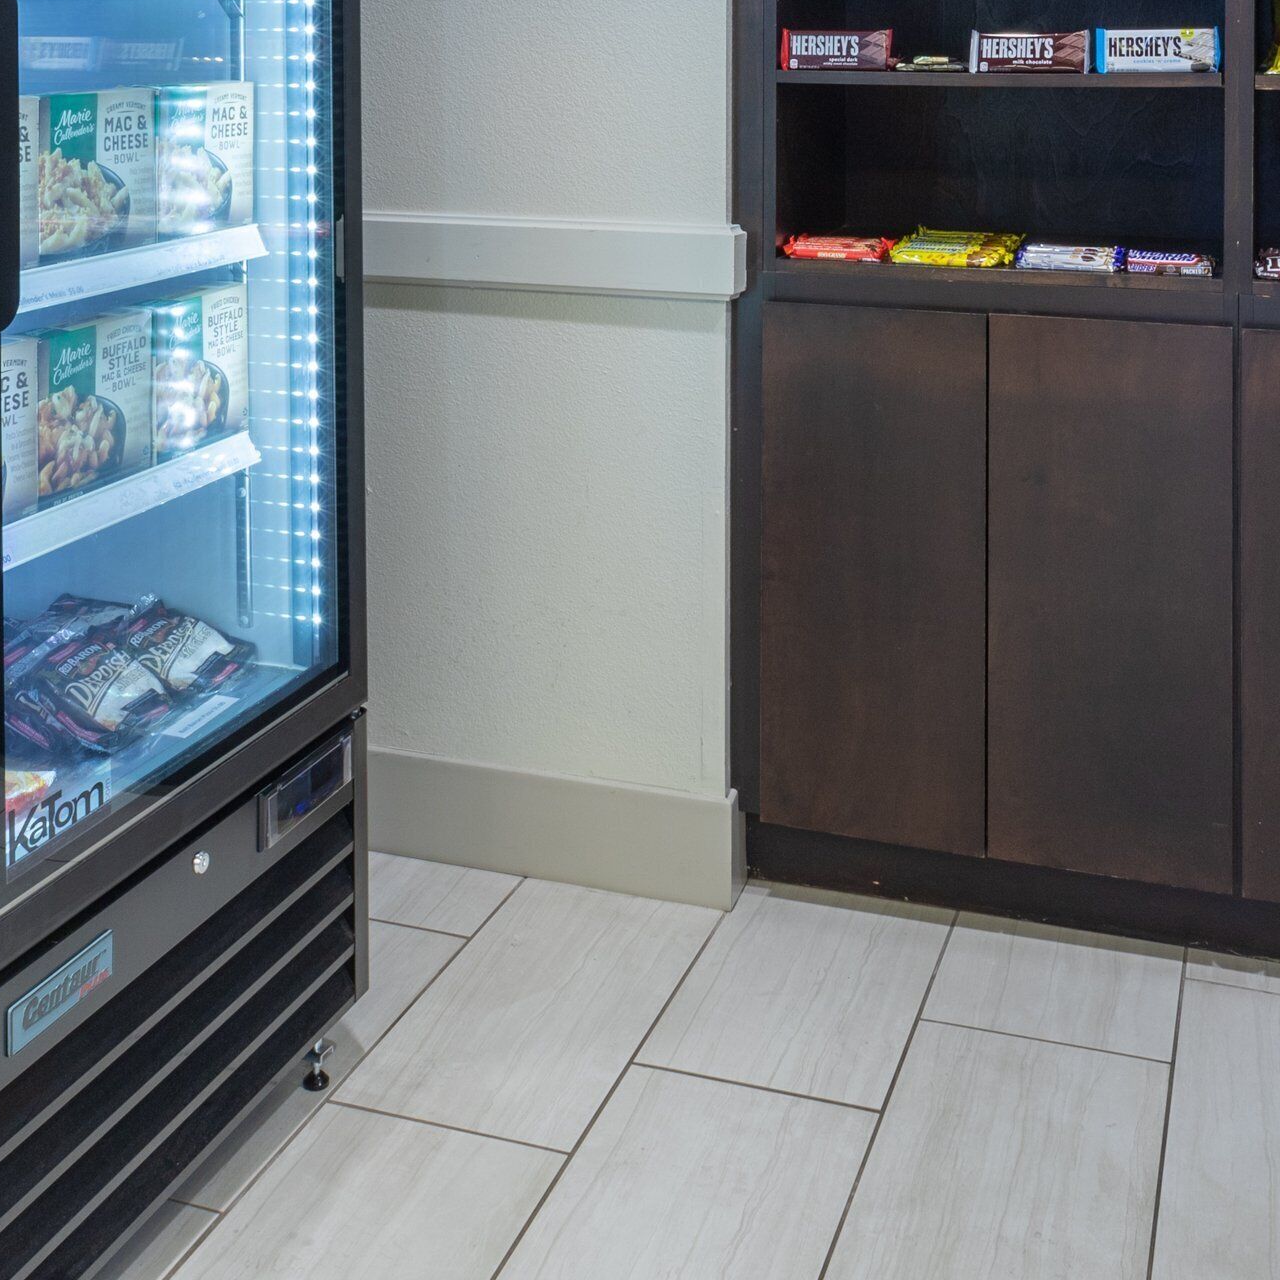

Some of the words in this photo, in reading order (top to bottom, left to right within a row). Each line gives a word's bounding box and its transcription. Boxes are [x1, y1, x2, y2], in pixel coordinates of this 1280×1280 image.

[792, 35, 860, 56] HERSHEY'S
[981, 37, 1054, 59] HERSHEY'S
[1108, 36, 1182, 58] HERSHEY'S
[54, 108, 92, 131] Marie
[104, 116, 132, 133] MAC
[137, 114, 148, 129] &
[103, 133, 149, 152] CHEESE
[114, 153, 140, 165] BOWL
[54, 342, 91, 370] Marie
[101, 336, 147, 360] BUFFALO
[108, 352, 140, 371] STYLE
[101, 371, 115, 383] MAC
[123, 362, 147, 377] CHEESE
[111, 377, 136, 393] BOWL
